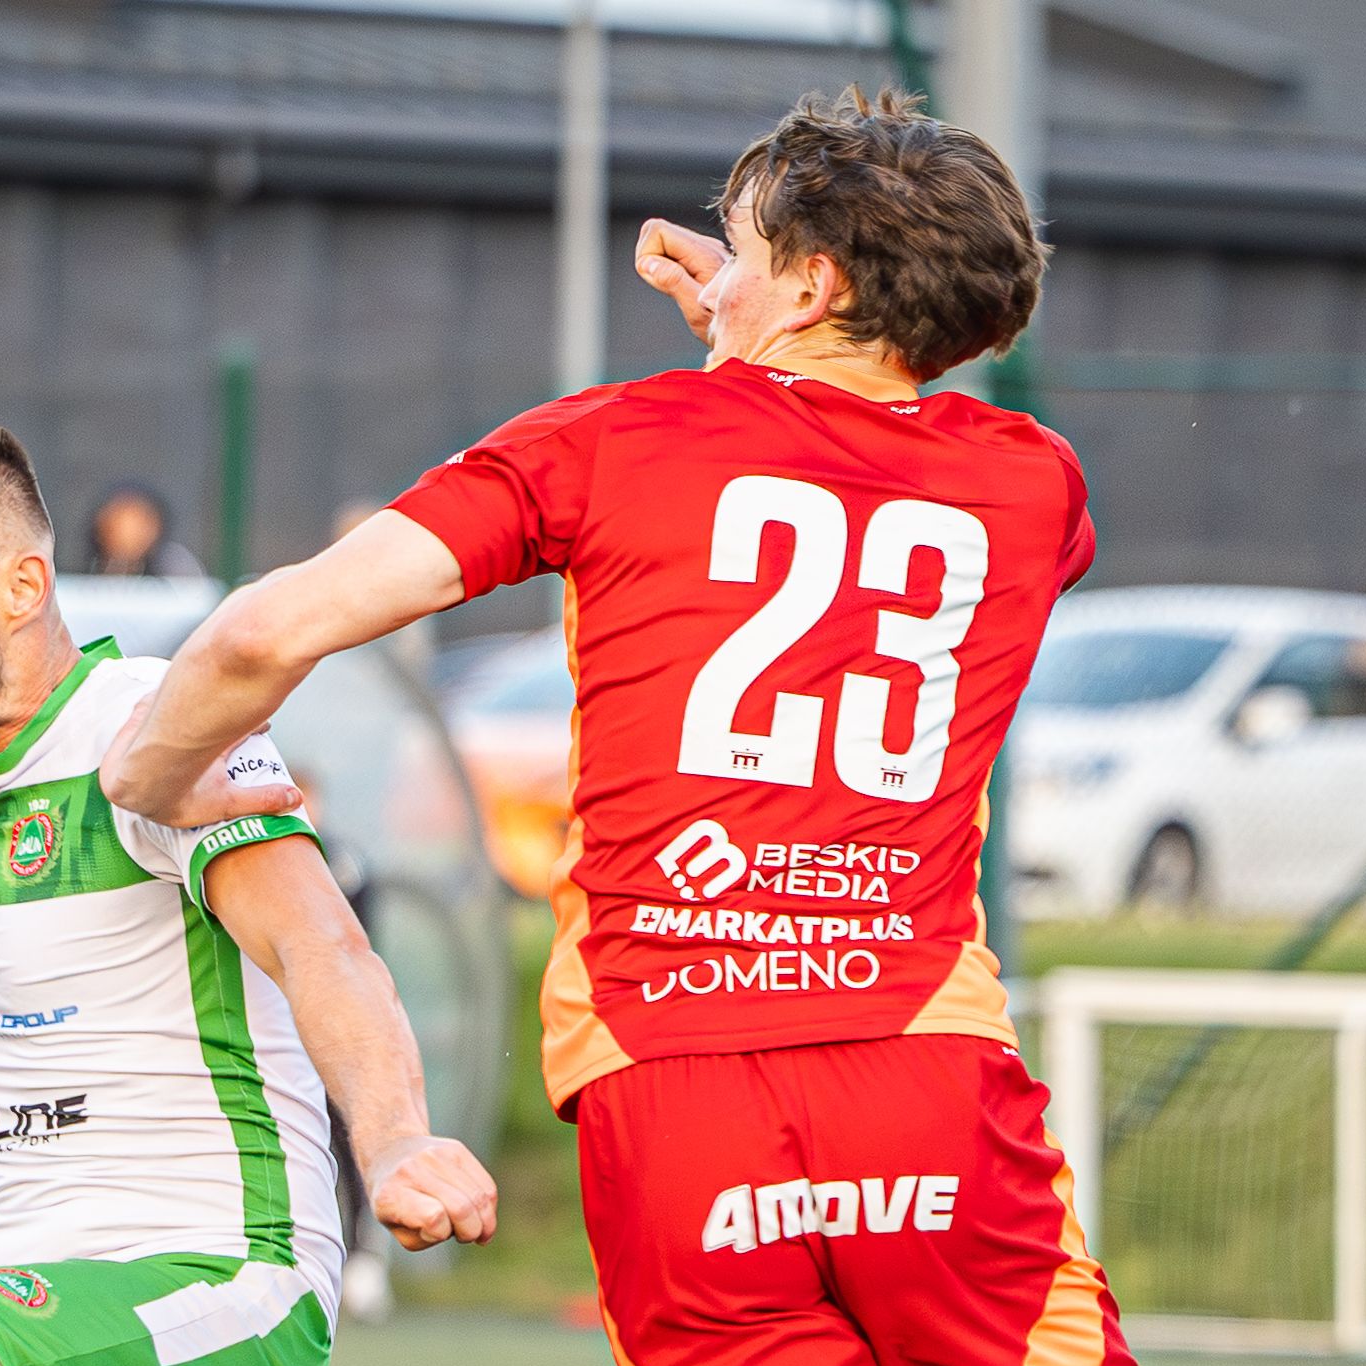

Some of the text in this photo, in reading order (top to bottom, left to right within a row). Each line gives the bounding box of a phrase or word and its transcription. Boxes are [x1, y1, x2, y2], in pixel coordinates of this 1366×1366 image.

[677, 475, 989, 803] 23
[201, 818, 268, 854] DALIN
[753, 842, 921, 875] BESKID
[746, 869, 891, 904] MEDIA
[656, 907, 915, 945] MARKATPLUS
[701, 1174, 960, 1254] 4MOVE
